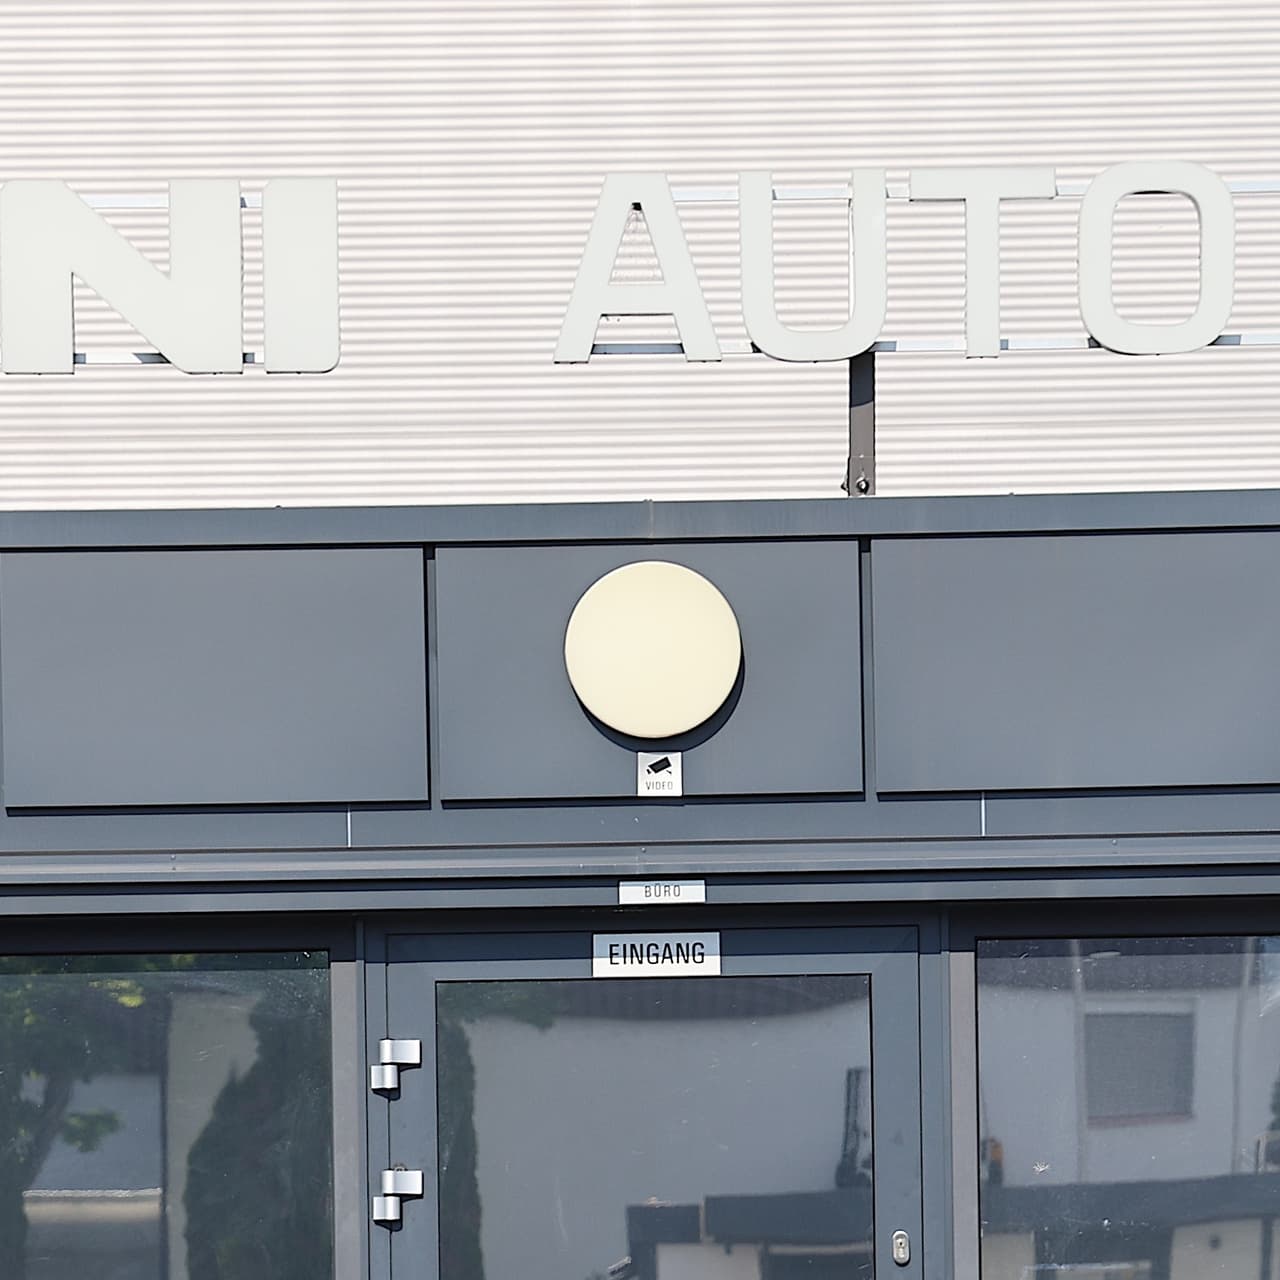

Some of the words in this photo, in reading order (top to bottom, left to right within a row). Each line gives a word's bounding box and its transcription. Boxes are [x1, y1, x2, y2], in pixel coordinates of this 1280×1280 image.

[552, 160, 1236, 364] AUTO
[645, 780, 674, 791] VIDEO
[608, 942, 706, 965] EINGANG
